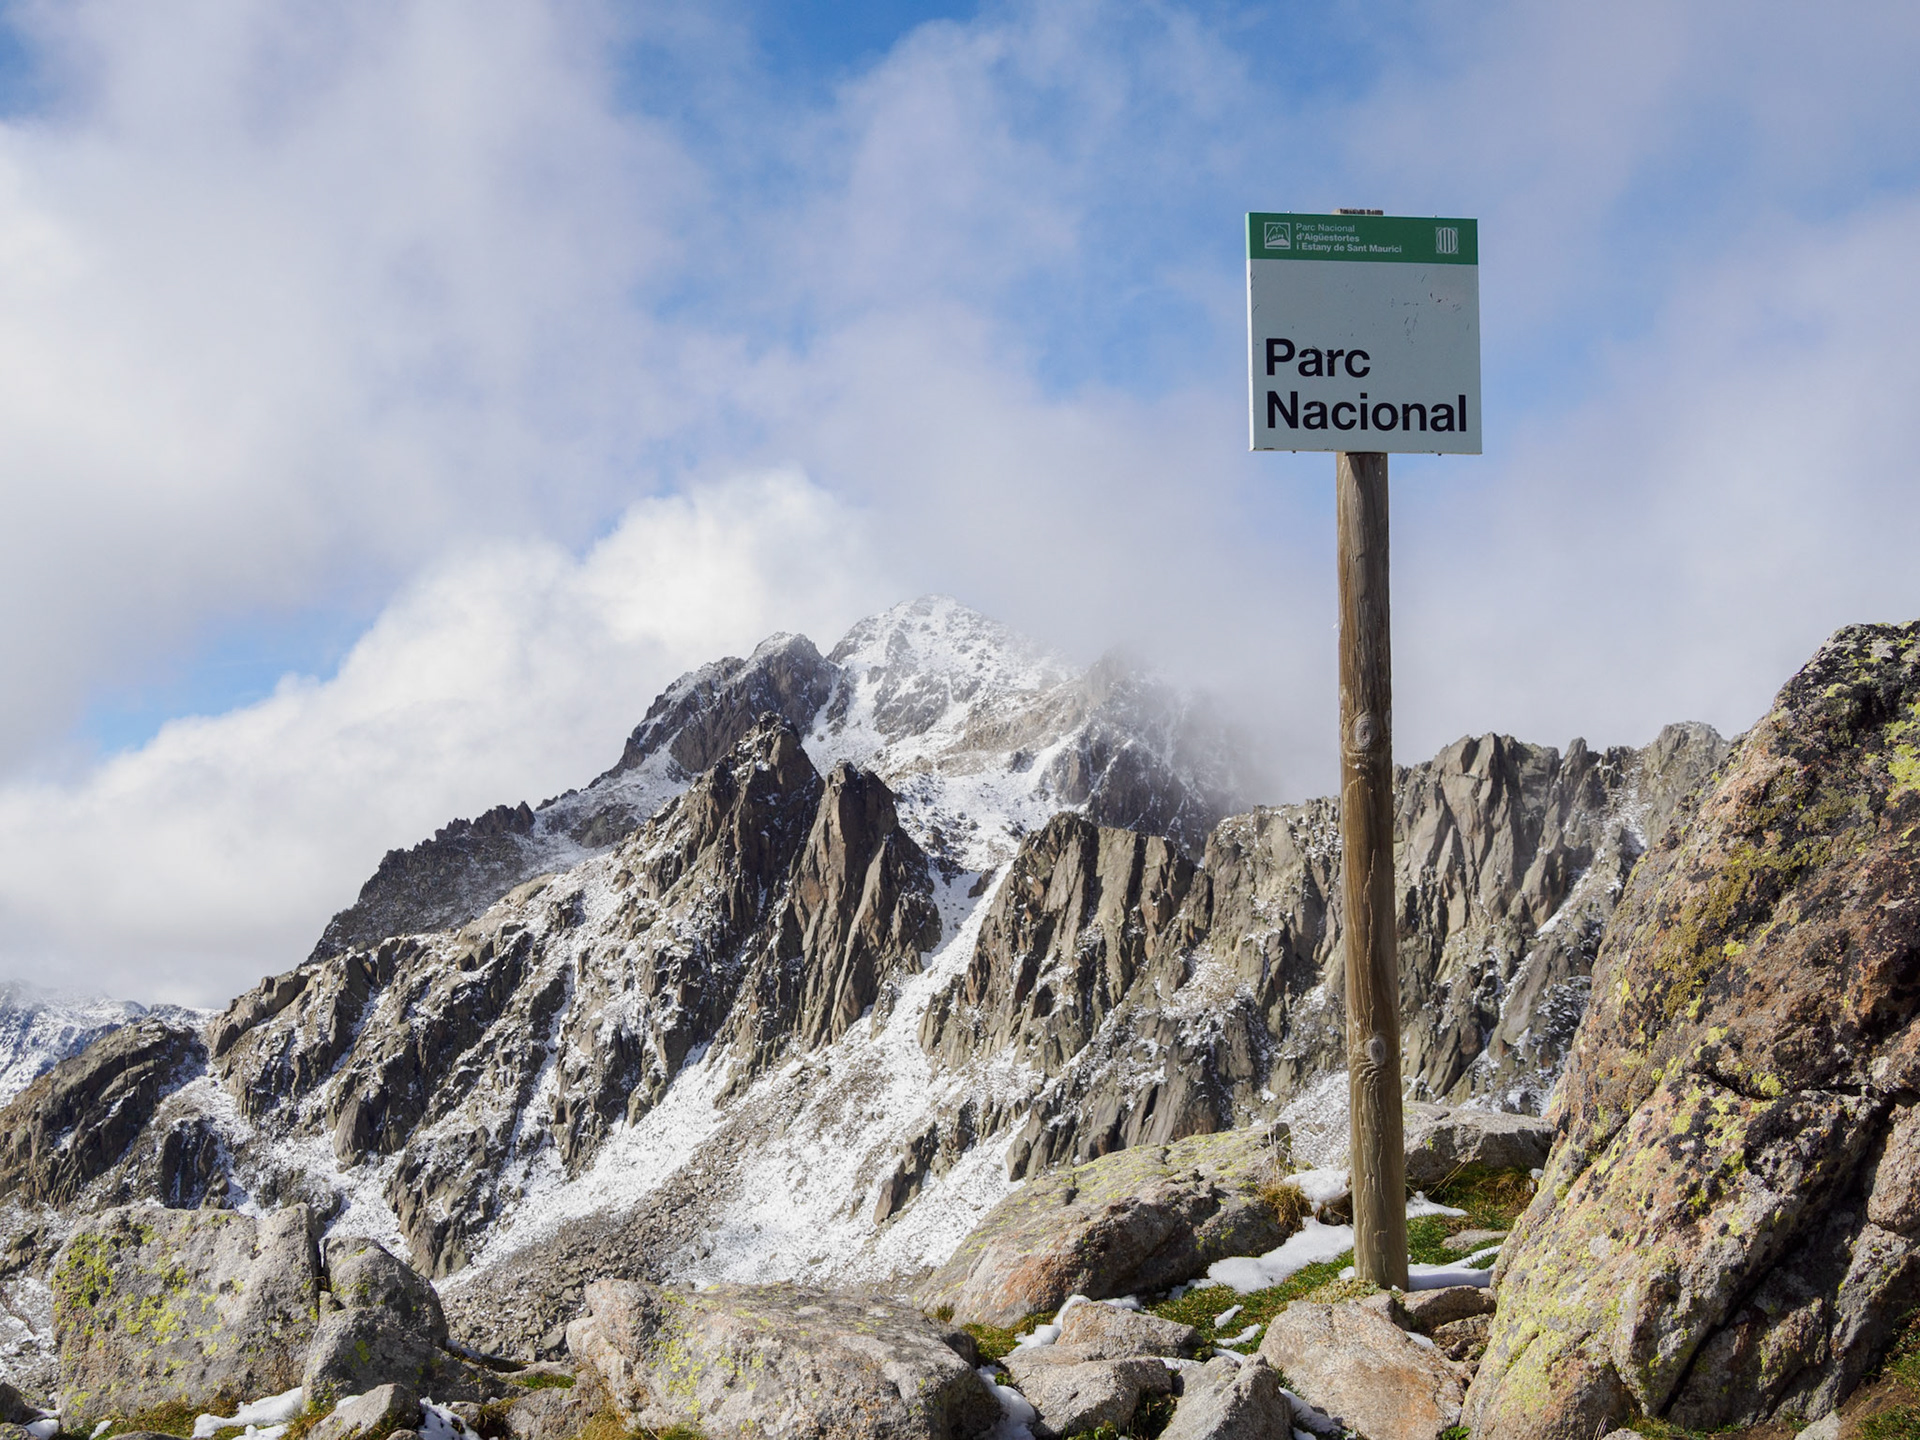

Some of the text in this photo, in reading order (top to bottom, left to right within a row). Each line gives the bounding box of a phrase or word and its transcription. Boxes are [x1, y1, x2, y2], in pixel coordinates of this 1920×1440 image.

[1296, 223, 1355, 232] Parc Nacional
[1296, 233, 1360, 243] d'Aigüestortes
[1301, 242, 1332, 253] Estany
[1334, 243, 1345, 252] de
[1347, 243, 1367, 252] Sant
[1370, 244, 1402, 253] Maurici
[1265, 338, 1371, 378] Parc
[1267, 390, 1467, 432] Nacional
